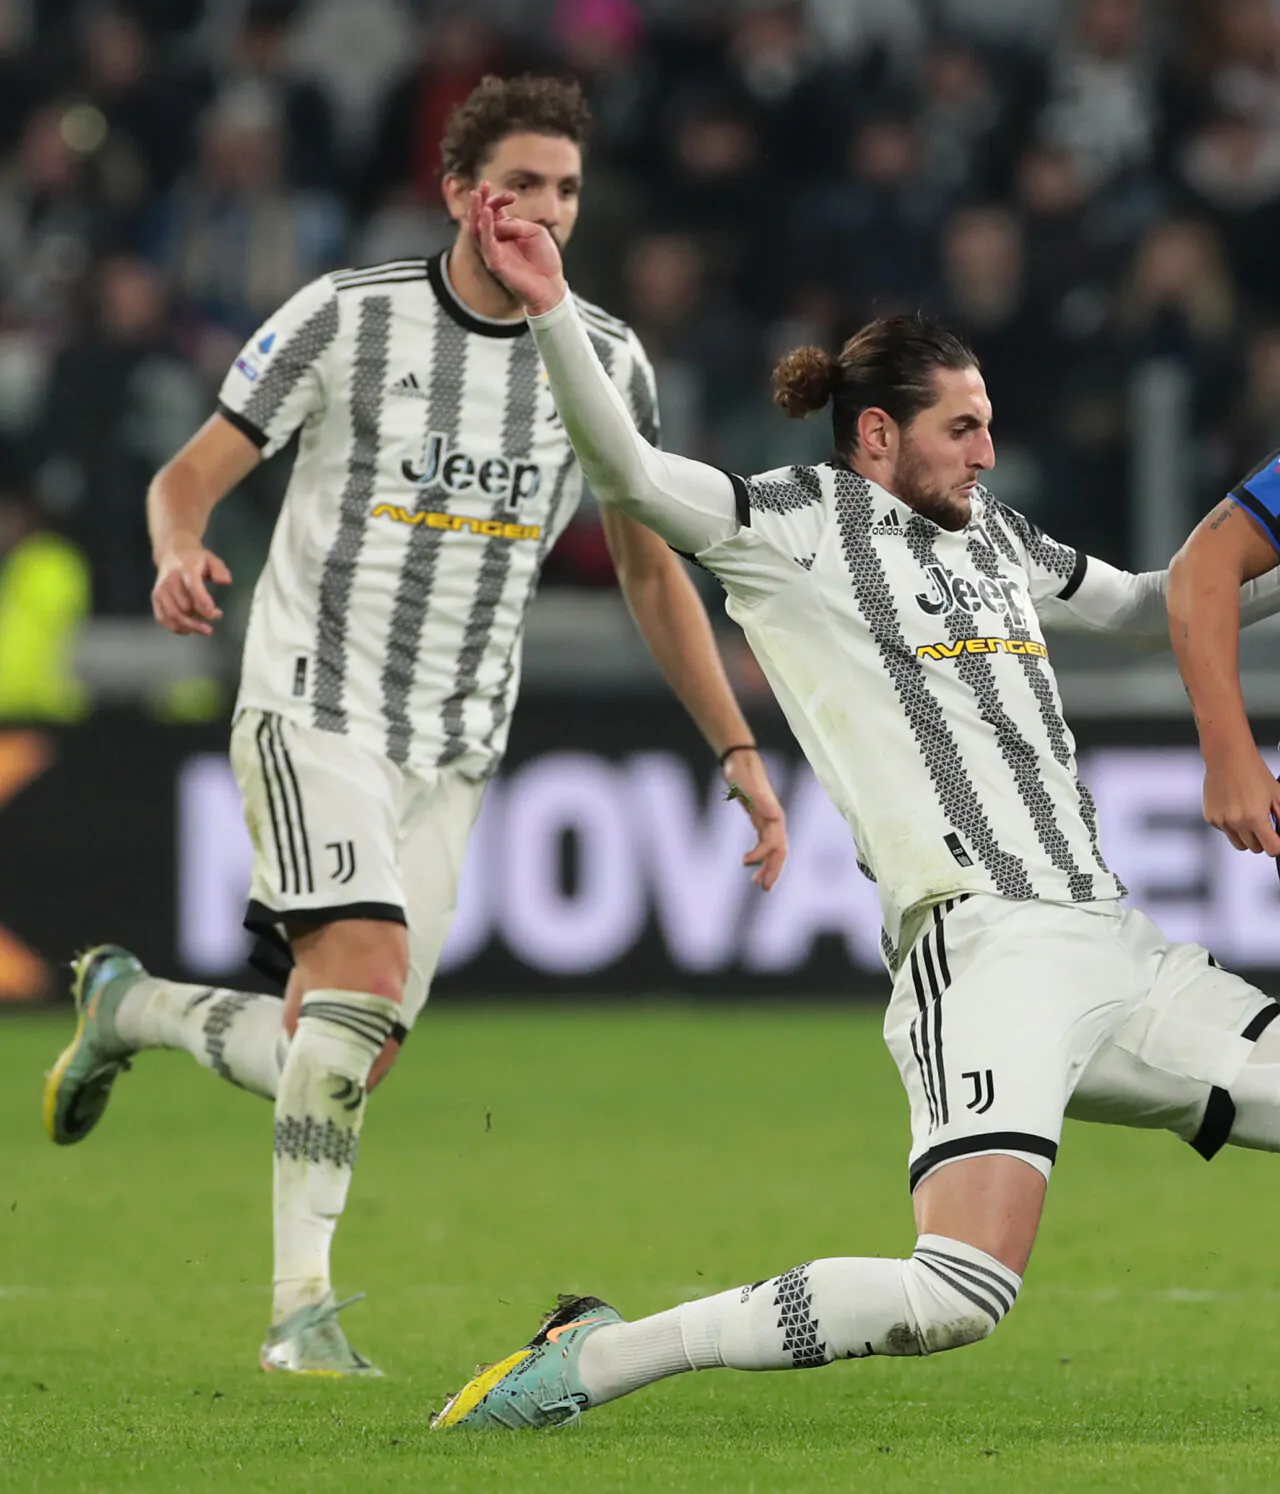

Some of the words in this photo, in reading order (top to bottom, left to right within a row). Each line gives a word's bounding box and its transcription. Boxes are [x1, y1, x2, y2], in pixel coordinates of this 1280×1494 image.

[399, 433, 544, 512] Jeep
[372, 502, 541, 541] AVENGER
[872, 524, 904, 536] adidas
[913, 564, 1026, 629] Jeep
